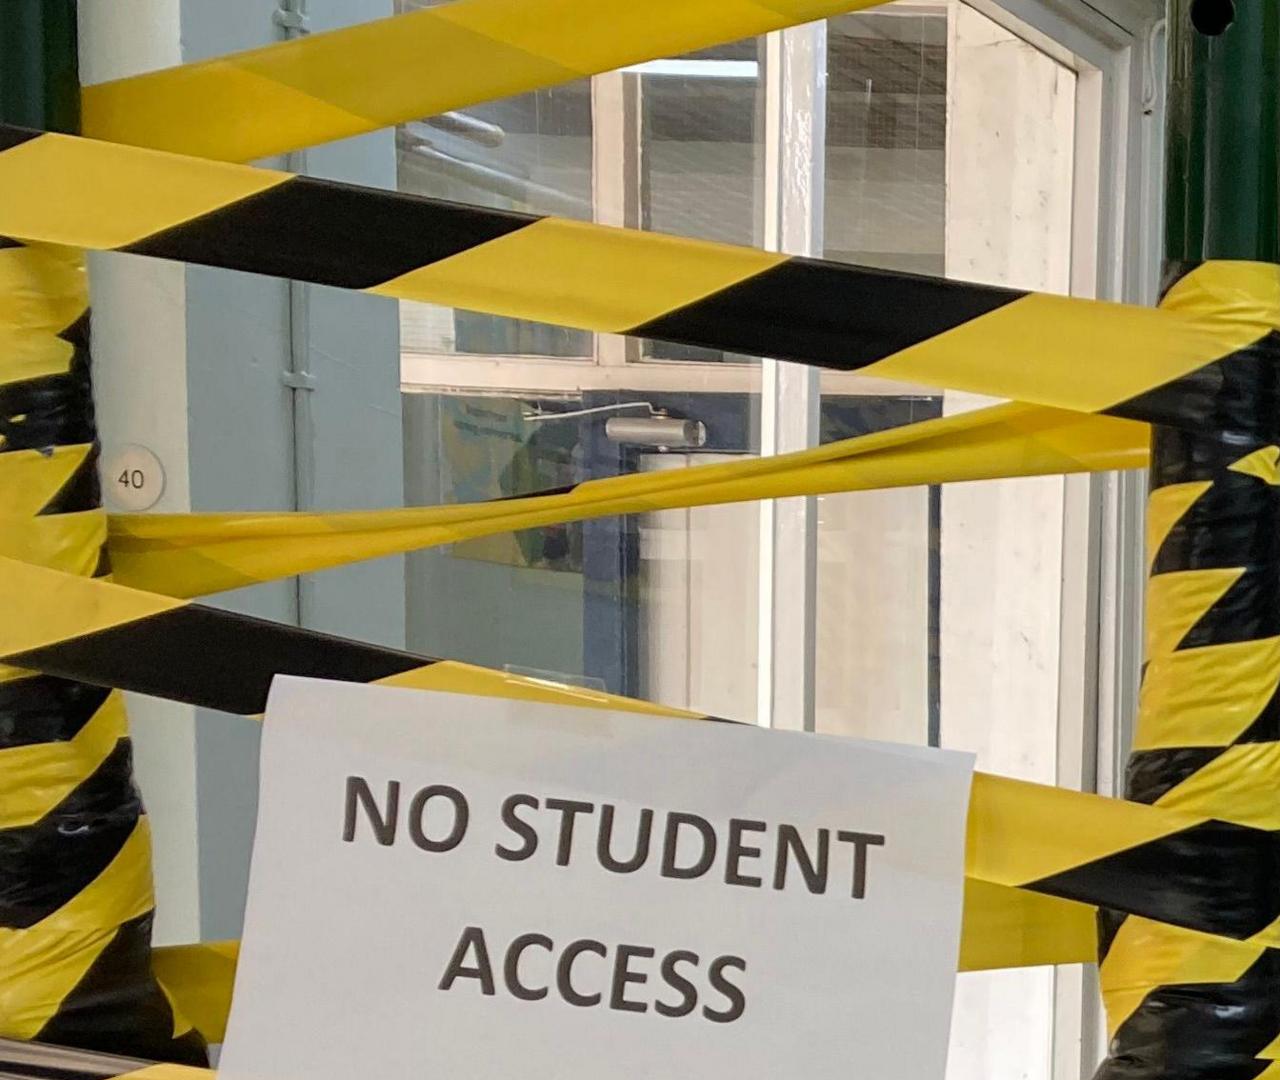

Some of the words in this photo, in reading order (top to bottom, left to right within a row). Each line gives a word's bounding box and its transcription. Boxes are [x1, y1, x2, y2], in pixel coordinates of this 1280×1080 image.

[118, 470, 144, 489] 40
[343, 776, 469, 853] NO
[494, 794, 886, 900] STUDENT
[438, 926, 747, 1024] ACCESS
